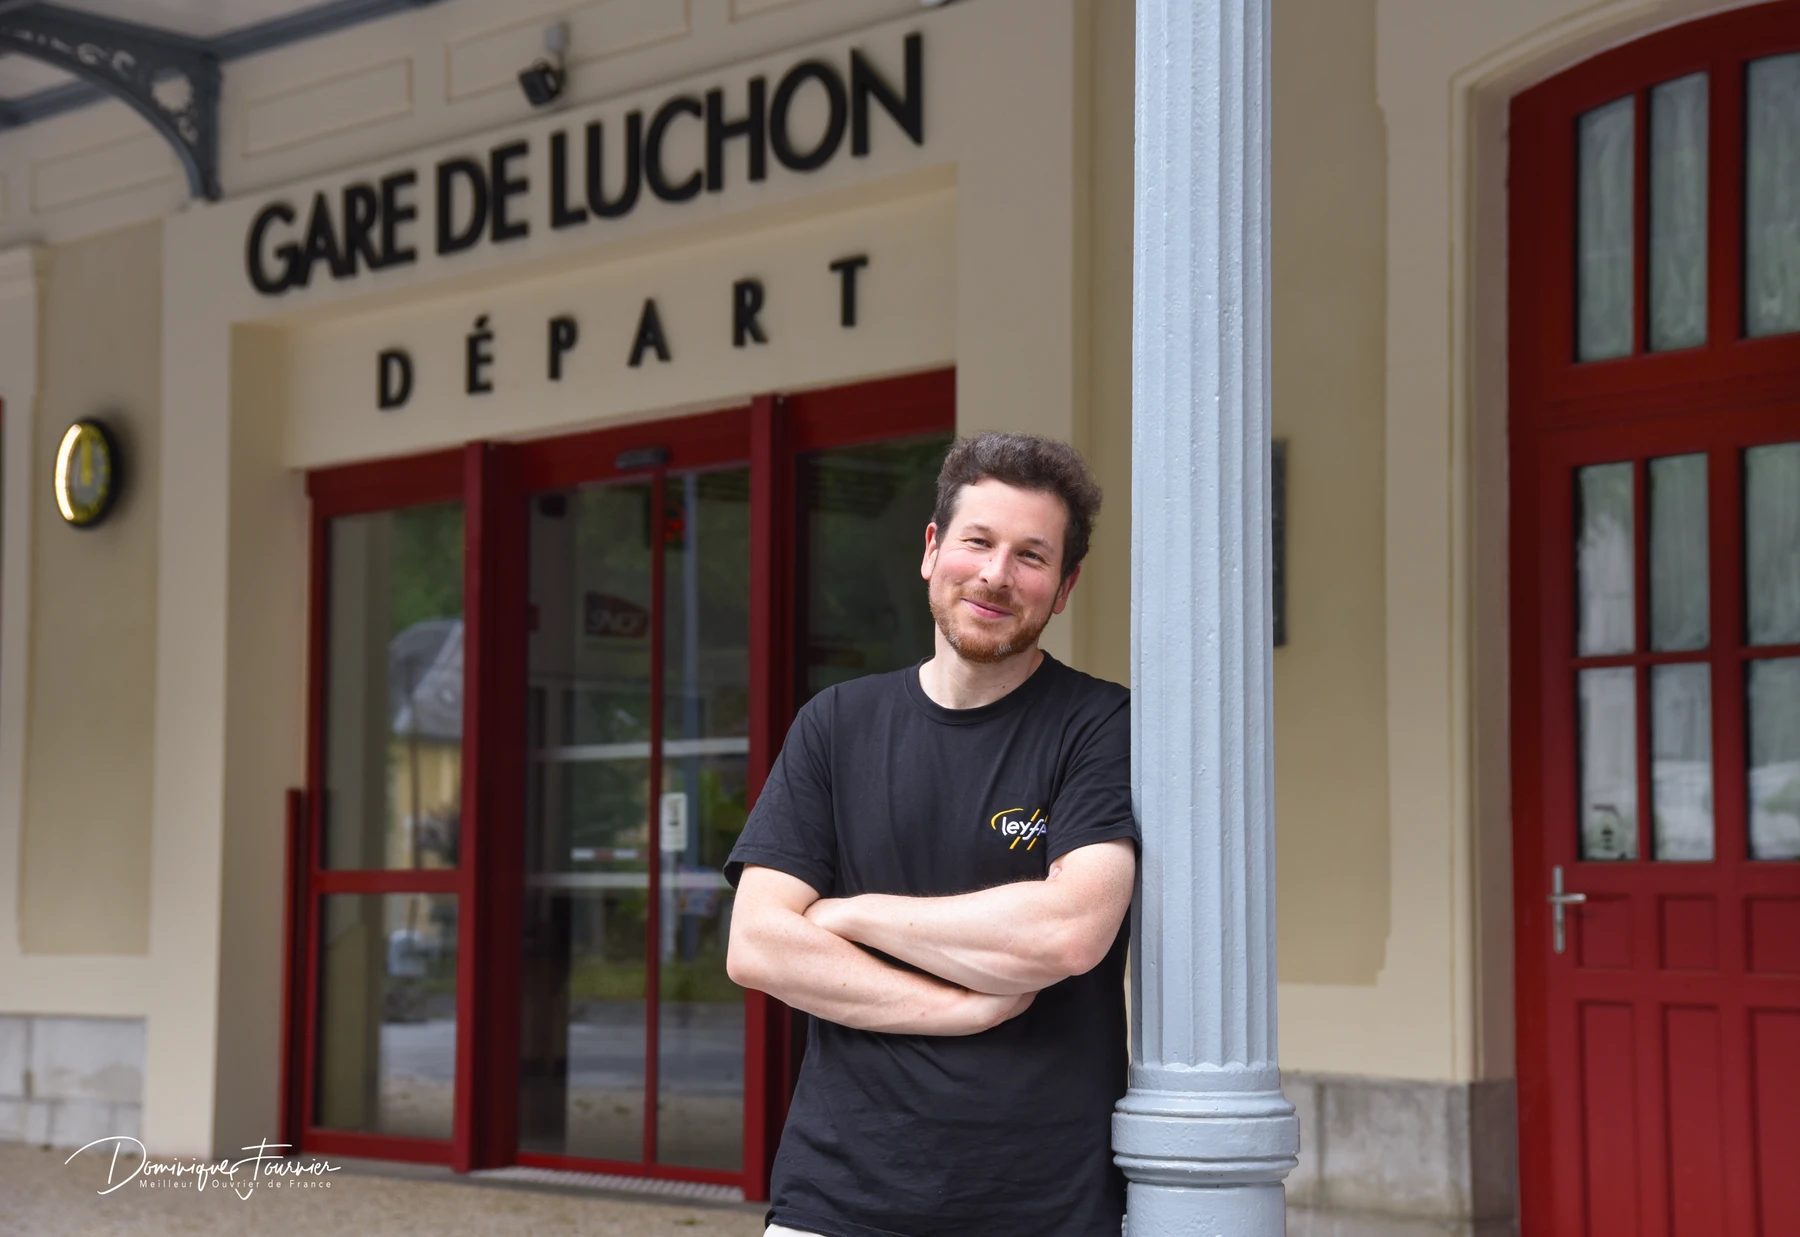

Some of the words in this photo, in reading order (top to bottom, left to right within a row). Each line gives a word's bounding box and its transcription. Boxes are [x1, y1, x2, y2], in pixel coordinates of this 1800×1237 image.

[245, 168, 418, 297] GARE
[435, 139, 529, 257] DE
[549, 31, 923, 230] LUCHON
[377, 254, 869, 410] DÉPART
